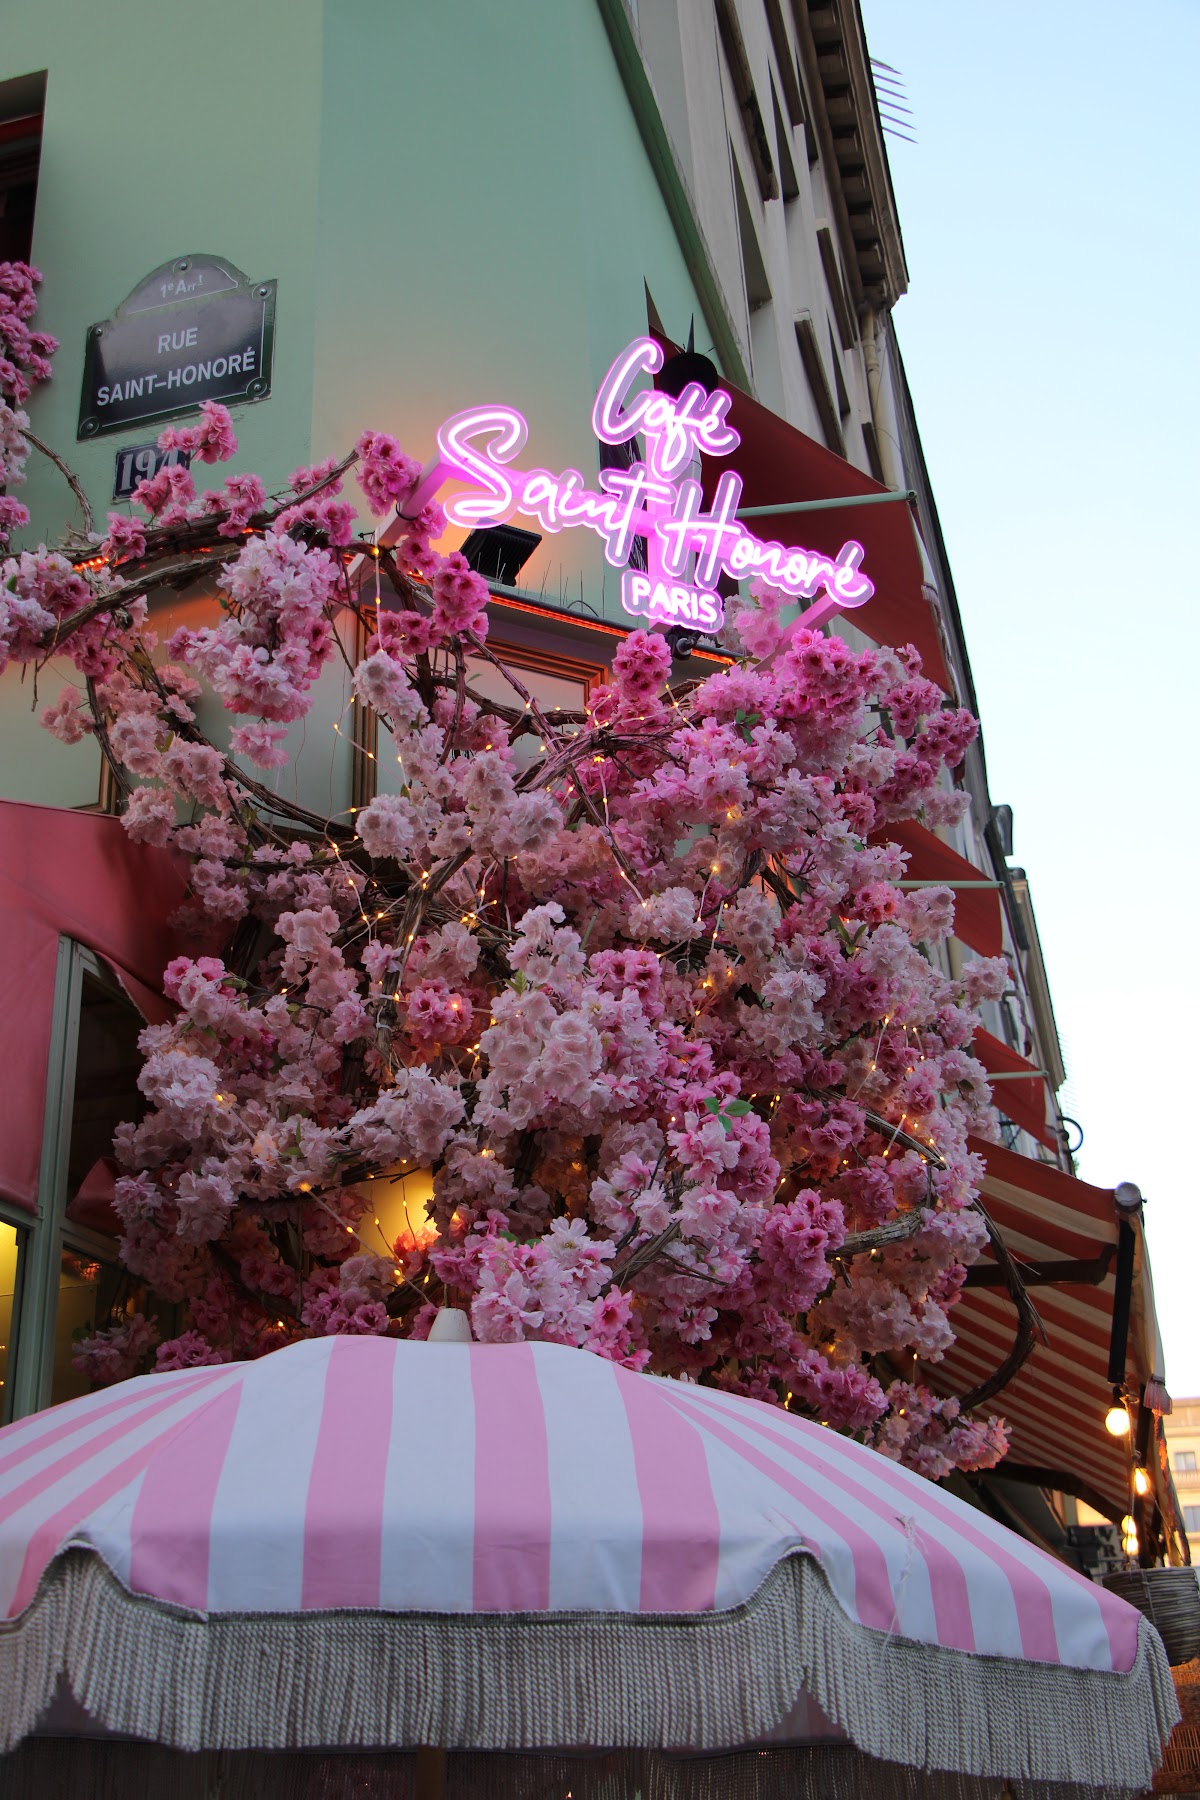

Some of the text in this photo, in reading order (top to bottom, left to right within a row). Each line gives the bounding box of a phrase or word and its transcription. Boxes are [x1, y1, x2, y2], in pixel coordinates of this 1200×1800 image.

[158, 328, 198, 353] RUE
[97, 347, 255, 406] SAINT-HONORÉ
[600, 339, 735, 472] Café
[445, 410, 869, 598] Saint Honoré
[629, 578, 718, 626] PARIS
